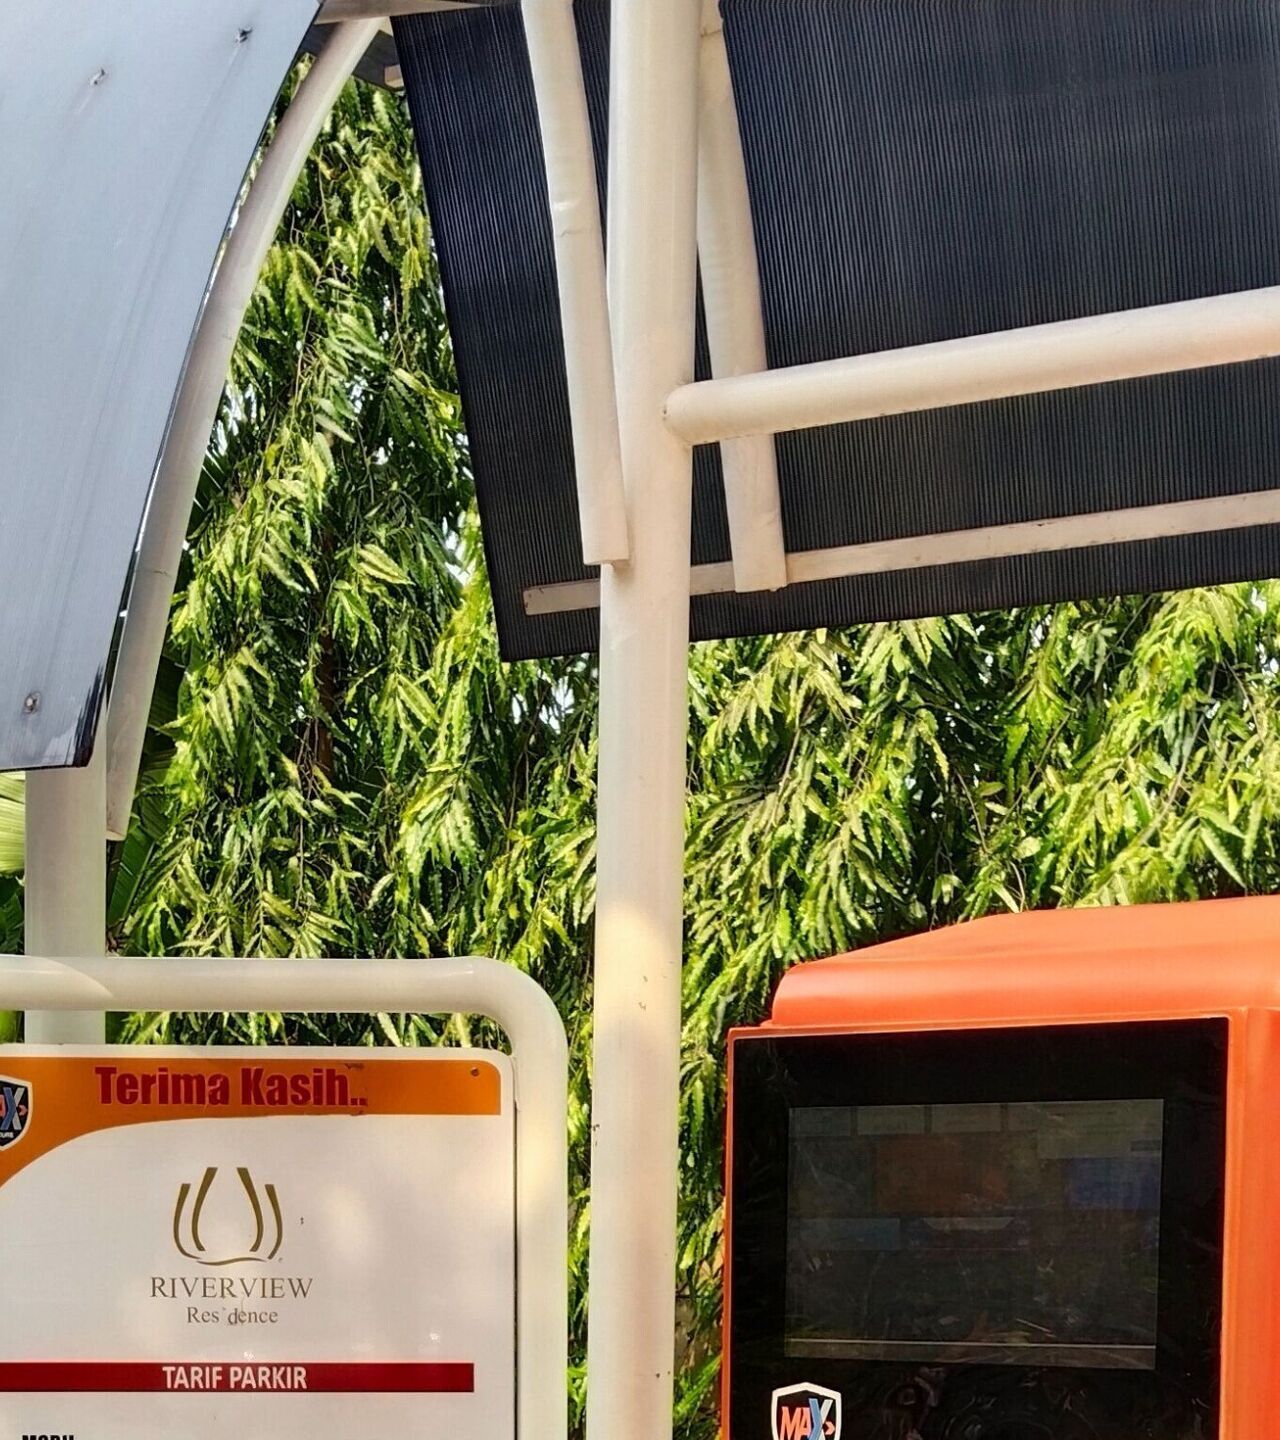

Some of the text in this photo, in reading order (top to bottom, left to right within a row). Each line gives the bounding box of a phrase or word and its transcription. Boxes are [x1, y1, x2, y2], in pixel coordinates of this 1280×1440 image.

[95, 1066, 230, 1107] Terima
[150, 1276, 313, 1299] RIVERVIEW
[187, 1305, 278, 1324] Resdence
[163, 1366, 306, 1388] TARIF PARKIR
